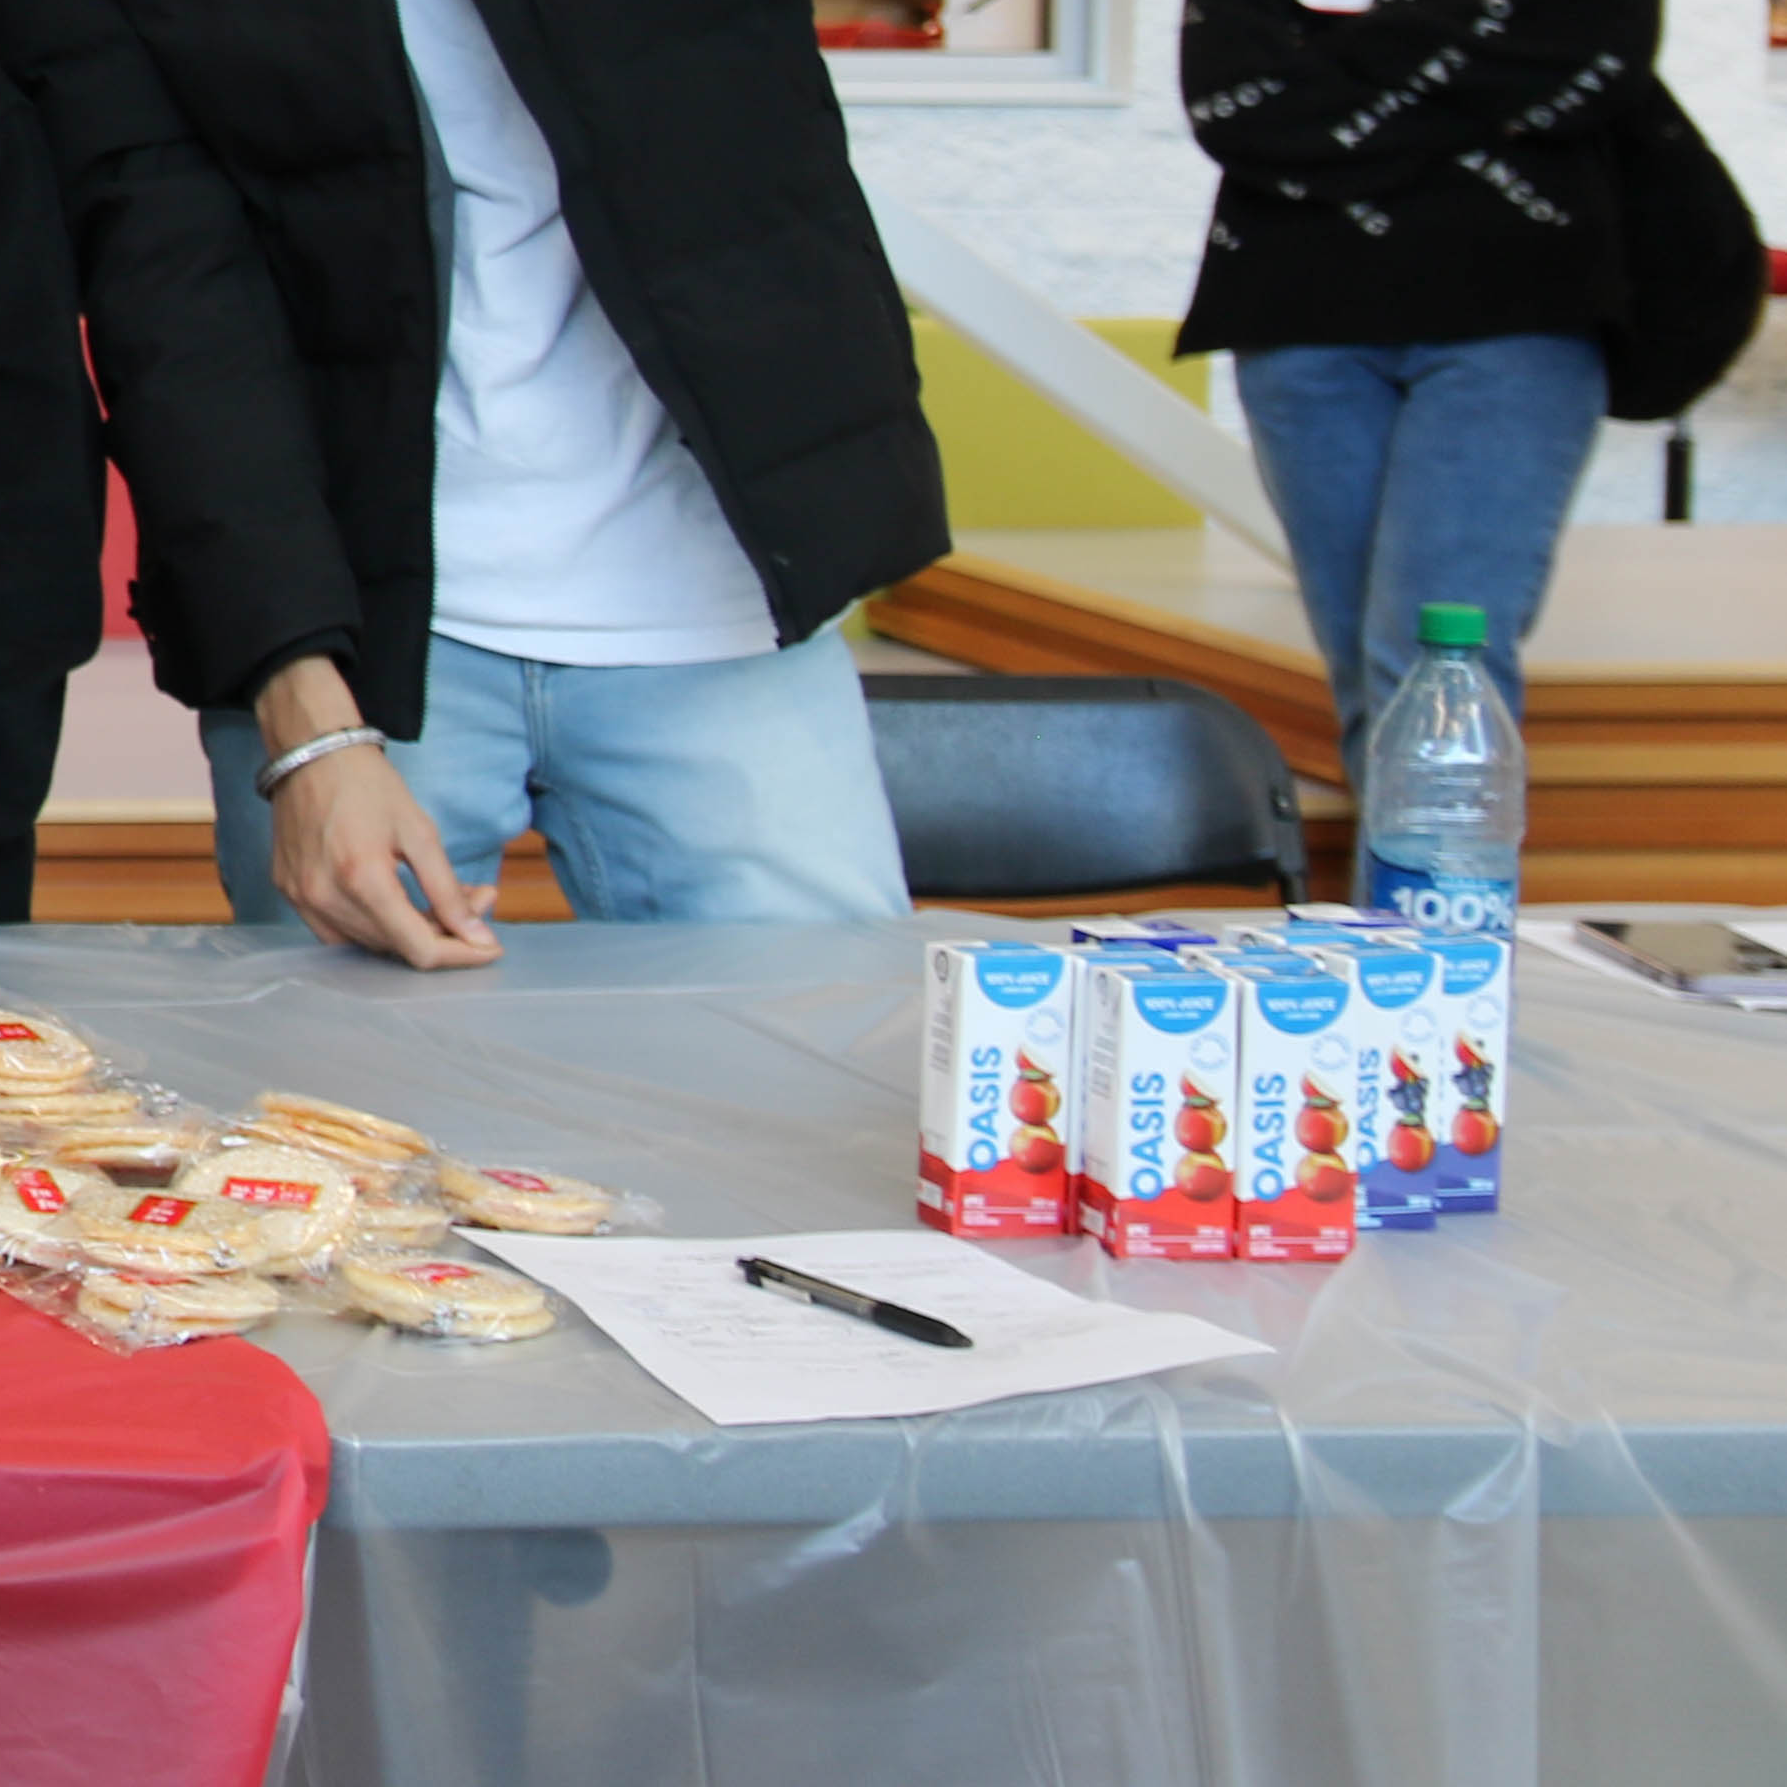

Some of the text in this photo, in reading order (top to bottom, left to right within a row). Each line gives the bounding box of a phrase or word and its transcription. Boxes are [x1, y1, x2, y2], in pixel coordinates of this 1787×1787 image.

[1389, 885, 1516, 932] 100%
[967, 1045, 1002, 1172] OASIS
[1129, 1072, 1166, 1202] OASIS
[1252, 1072, 1287, 1202] OASIS
